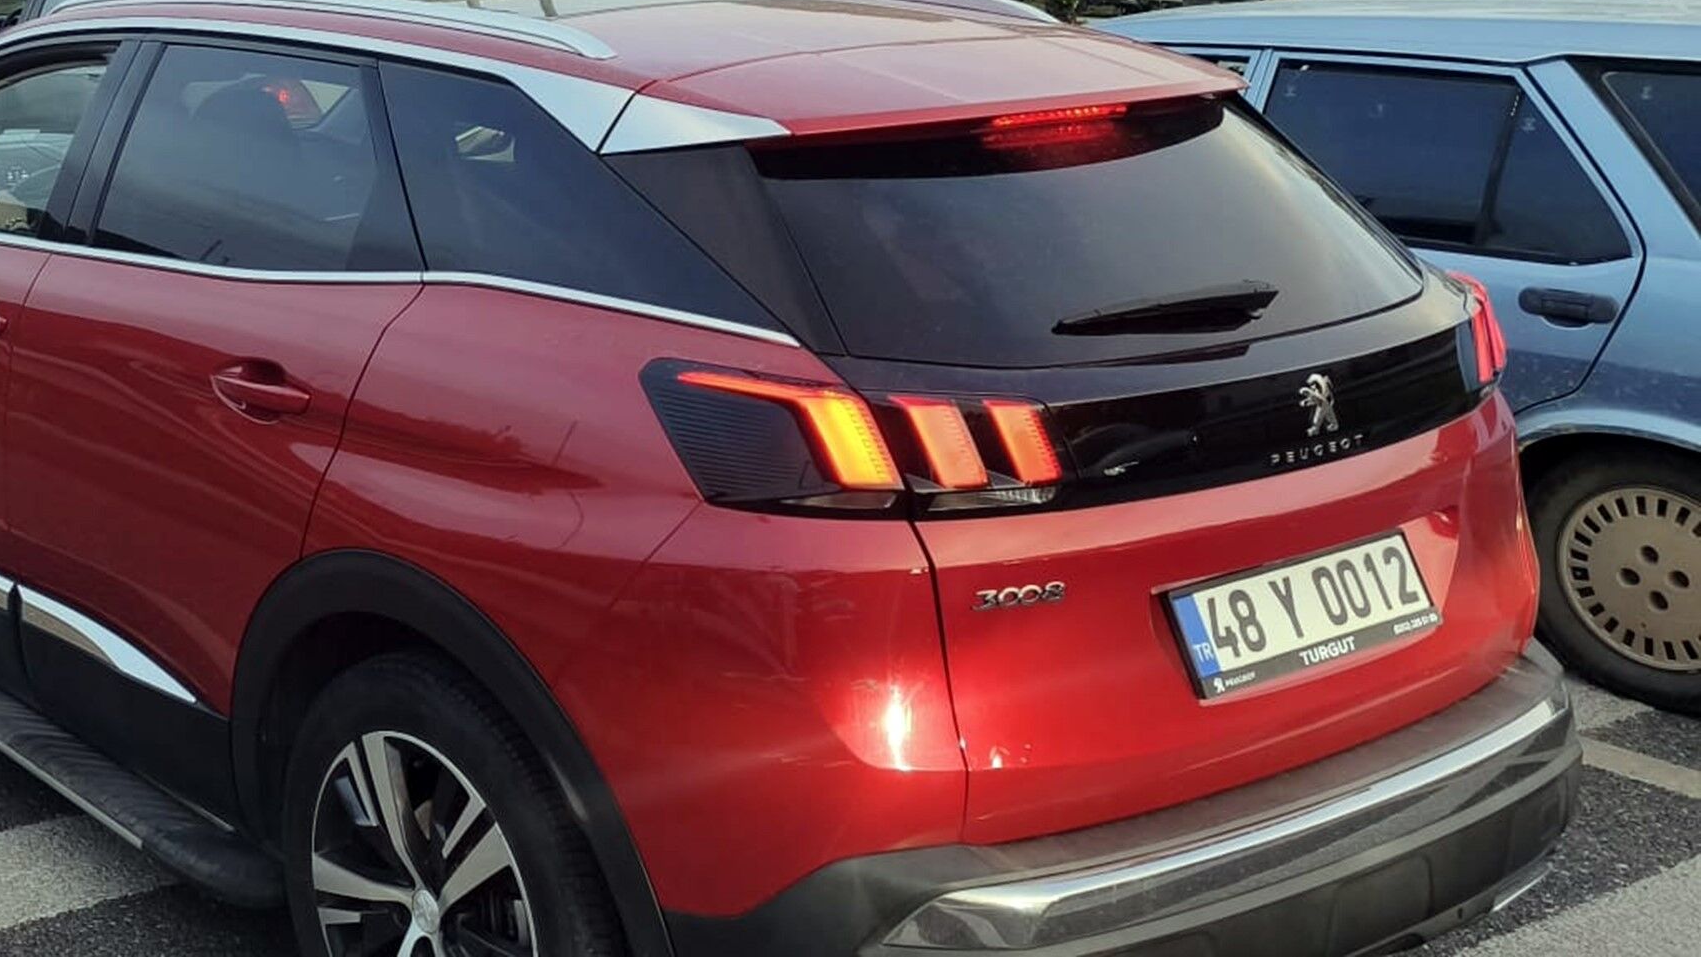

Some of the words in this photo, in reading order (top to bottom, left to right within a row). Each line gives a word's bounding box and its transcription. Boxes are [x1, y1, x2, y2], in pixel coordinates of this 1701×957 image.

[1270, 434, 1364, 464] PEUGEOT
[970, 581, 1065, 612] 3008
[1192, 643, 1215, 663] TR
[1207, 589, 1267, 658] 48
[1268, 576, 1305, 639] Y
[1311, 546, 1421, 626] 0012
[1299, 636, 1356, 666] TURGUT
